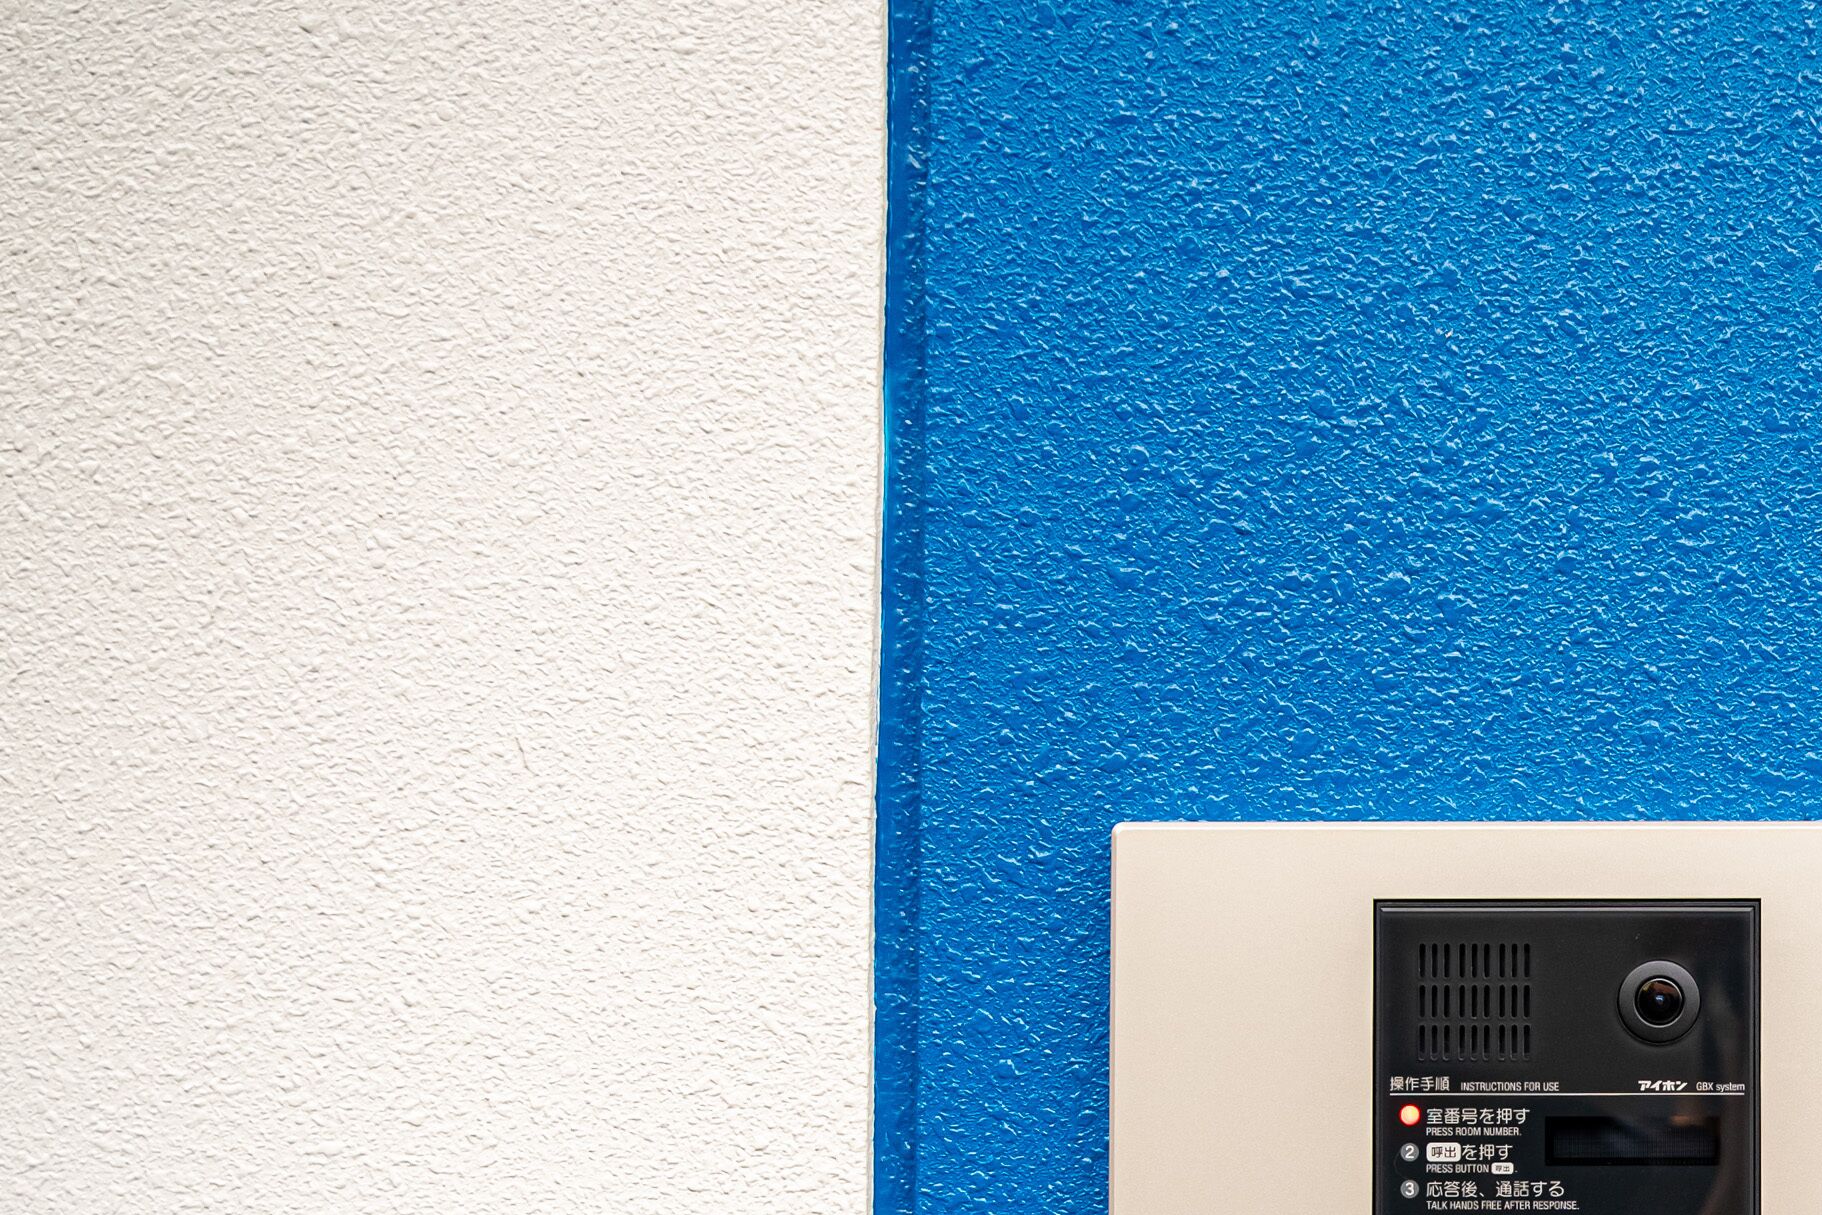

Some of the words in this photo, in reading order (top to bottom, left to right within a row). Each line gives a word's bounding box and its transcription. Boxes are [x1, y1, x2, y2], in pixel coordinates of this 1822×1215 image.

[1389, 1076, 1450, 1092] 操作手順
[1460, 1082, 1522, 1092] INSTRUCTIONS
[1523, 1082, 1541, 1092] FOR
[1542, 1082, 1560, 1092] USE
[1638, 1080, 1688, 1091] アイホン
[1696, 1081, 1714, 1091] GBX
[1715, 1082, 1746, 1093] system
[1426, 1107, 1531, 1125] 室番号を押す
[1426, 1127, 1454, 1136] PRESS
[1455, 1127, 1482, 1136] ROOM
[1483, 1127, 1522, 1136] NUMBER.
[1425, 1164, 1454, 1173] PRESS
[1455, 1164, 1489, 1173] BUTTON
[1426, 1201, 1448, 1210] TALK
[1449, 1201, 1479, 1210] HANDS
[1481, 1201, 1502, 1210] FREE
[1504, 1201, 1531, 1210] AFTER
[1532, 1201, 1580, 1210] RESPONSE.
